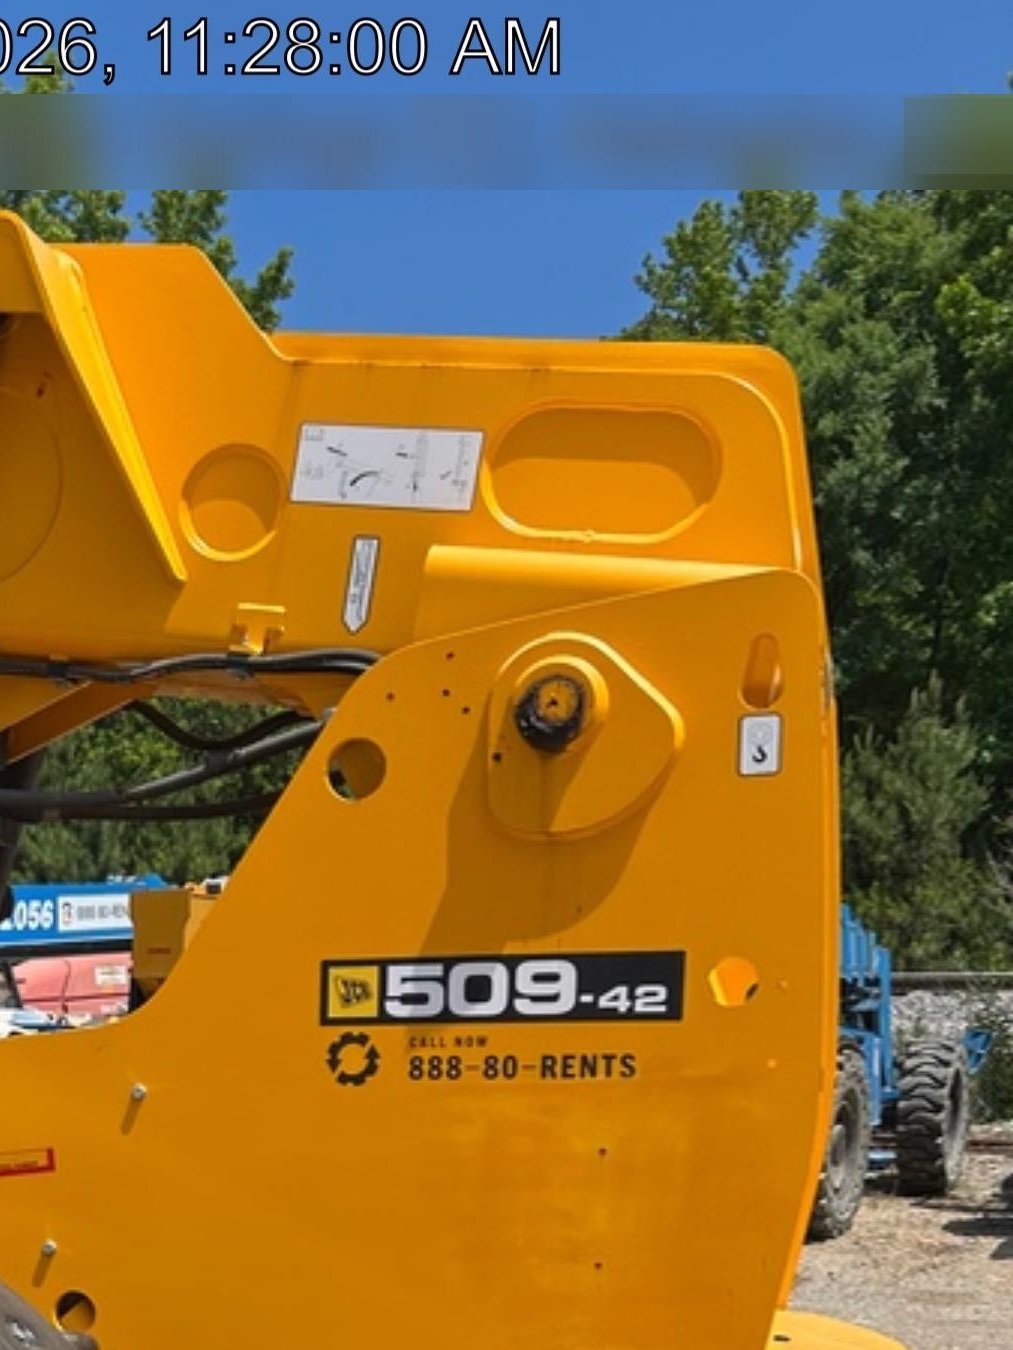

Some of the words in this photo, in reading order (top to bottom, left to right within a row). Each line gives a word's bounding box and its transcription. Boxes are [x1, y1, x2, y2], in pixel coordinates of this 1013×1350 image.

[0, 899, 54, 932] 056
[384, 958, 669, 1019] 509-42
[408, 1035, 448, 1049] CALL
[454, 1035, 488, 1048] NOW
[408, 1053, 637, 1081] 888-80-RENTS
